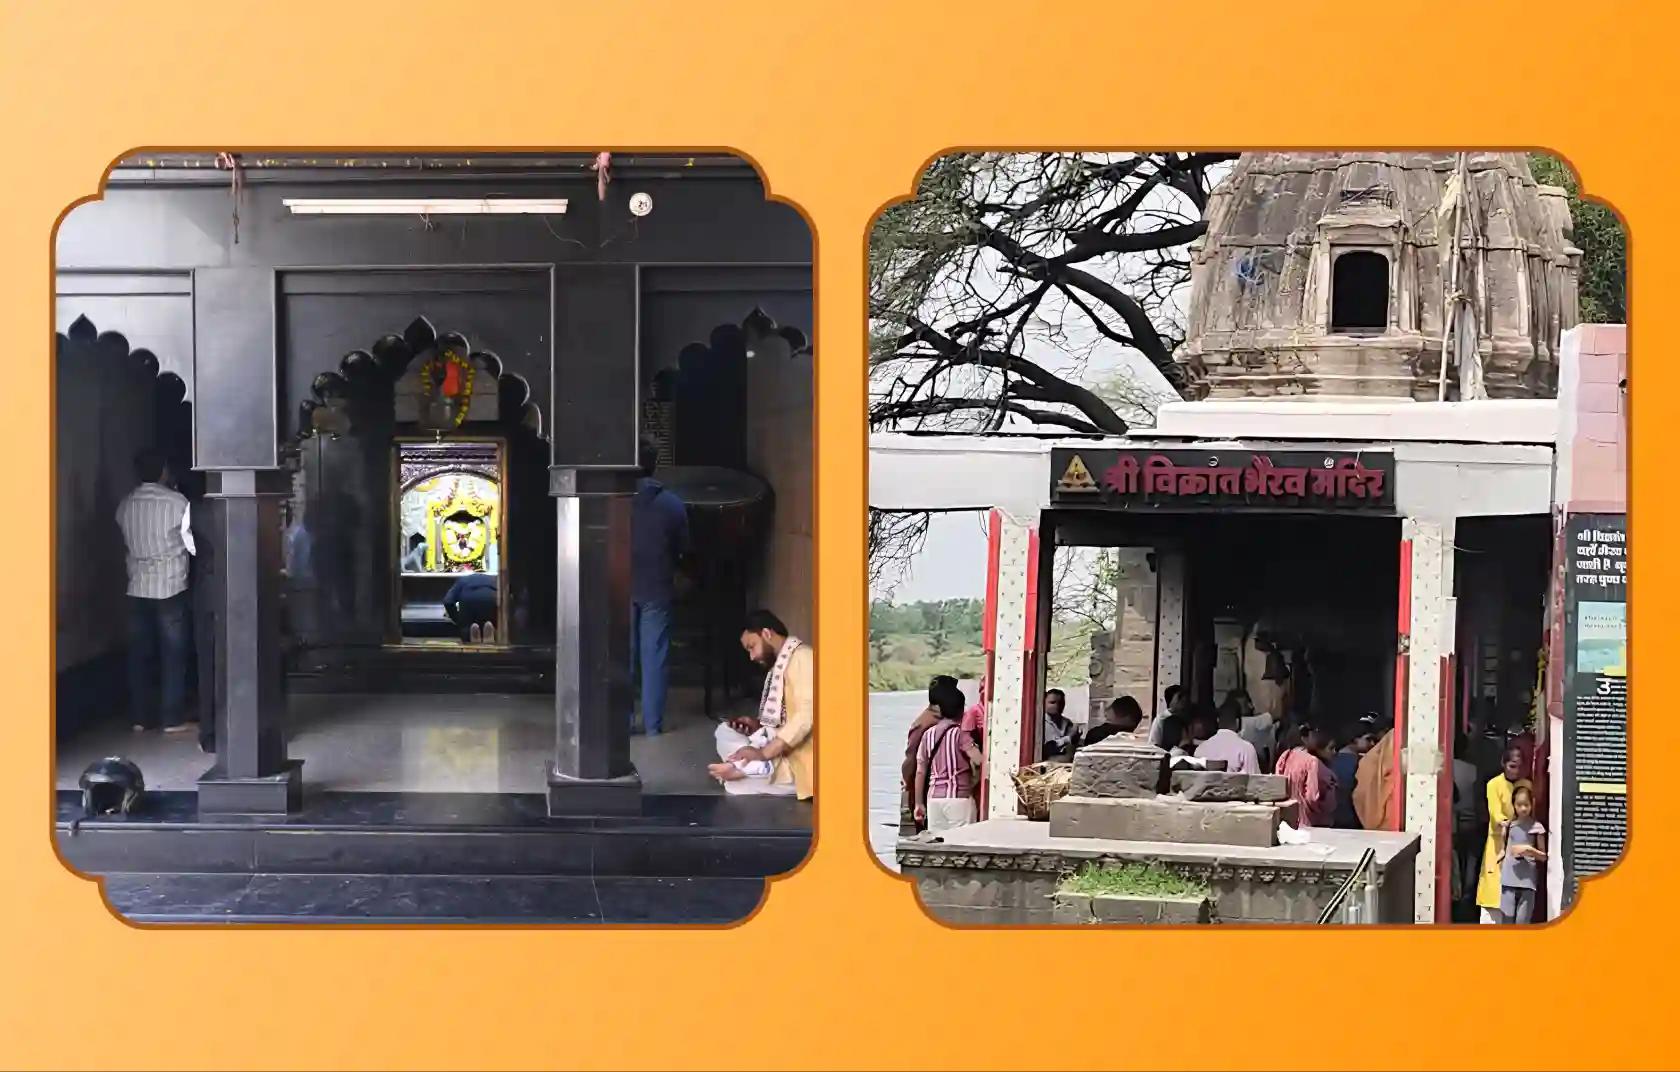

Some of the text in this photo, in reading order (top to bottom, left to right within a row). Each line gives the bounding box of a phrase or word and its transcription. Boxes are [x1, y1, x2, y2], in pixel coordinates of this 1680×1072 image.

[1104, 454, 1385, 498] श्री विक्रांत भैरव मंदिर
